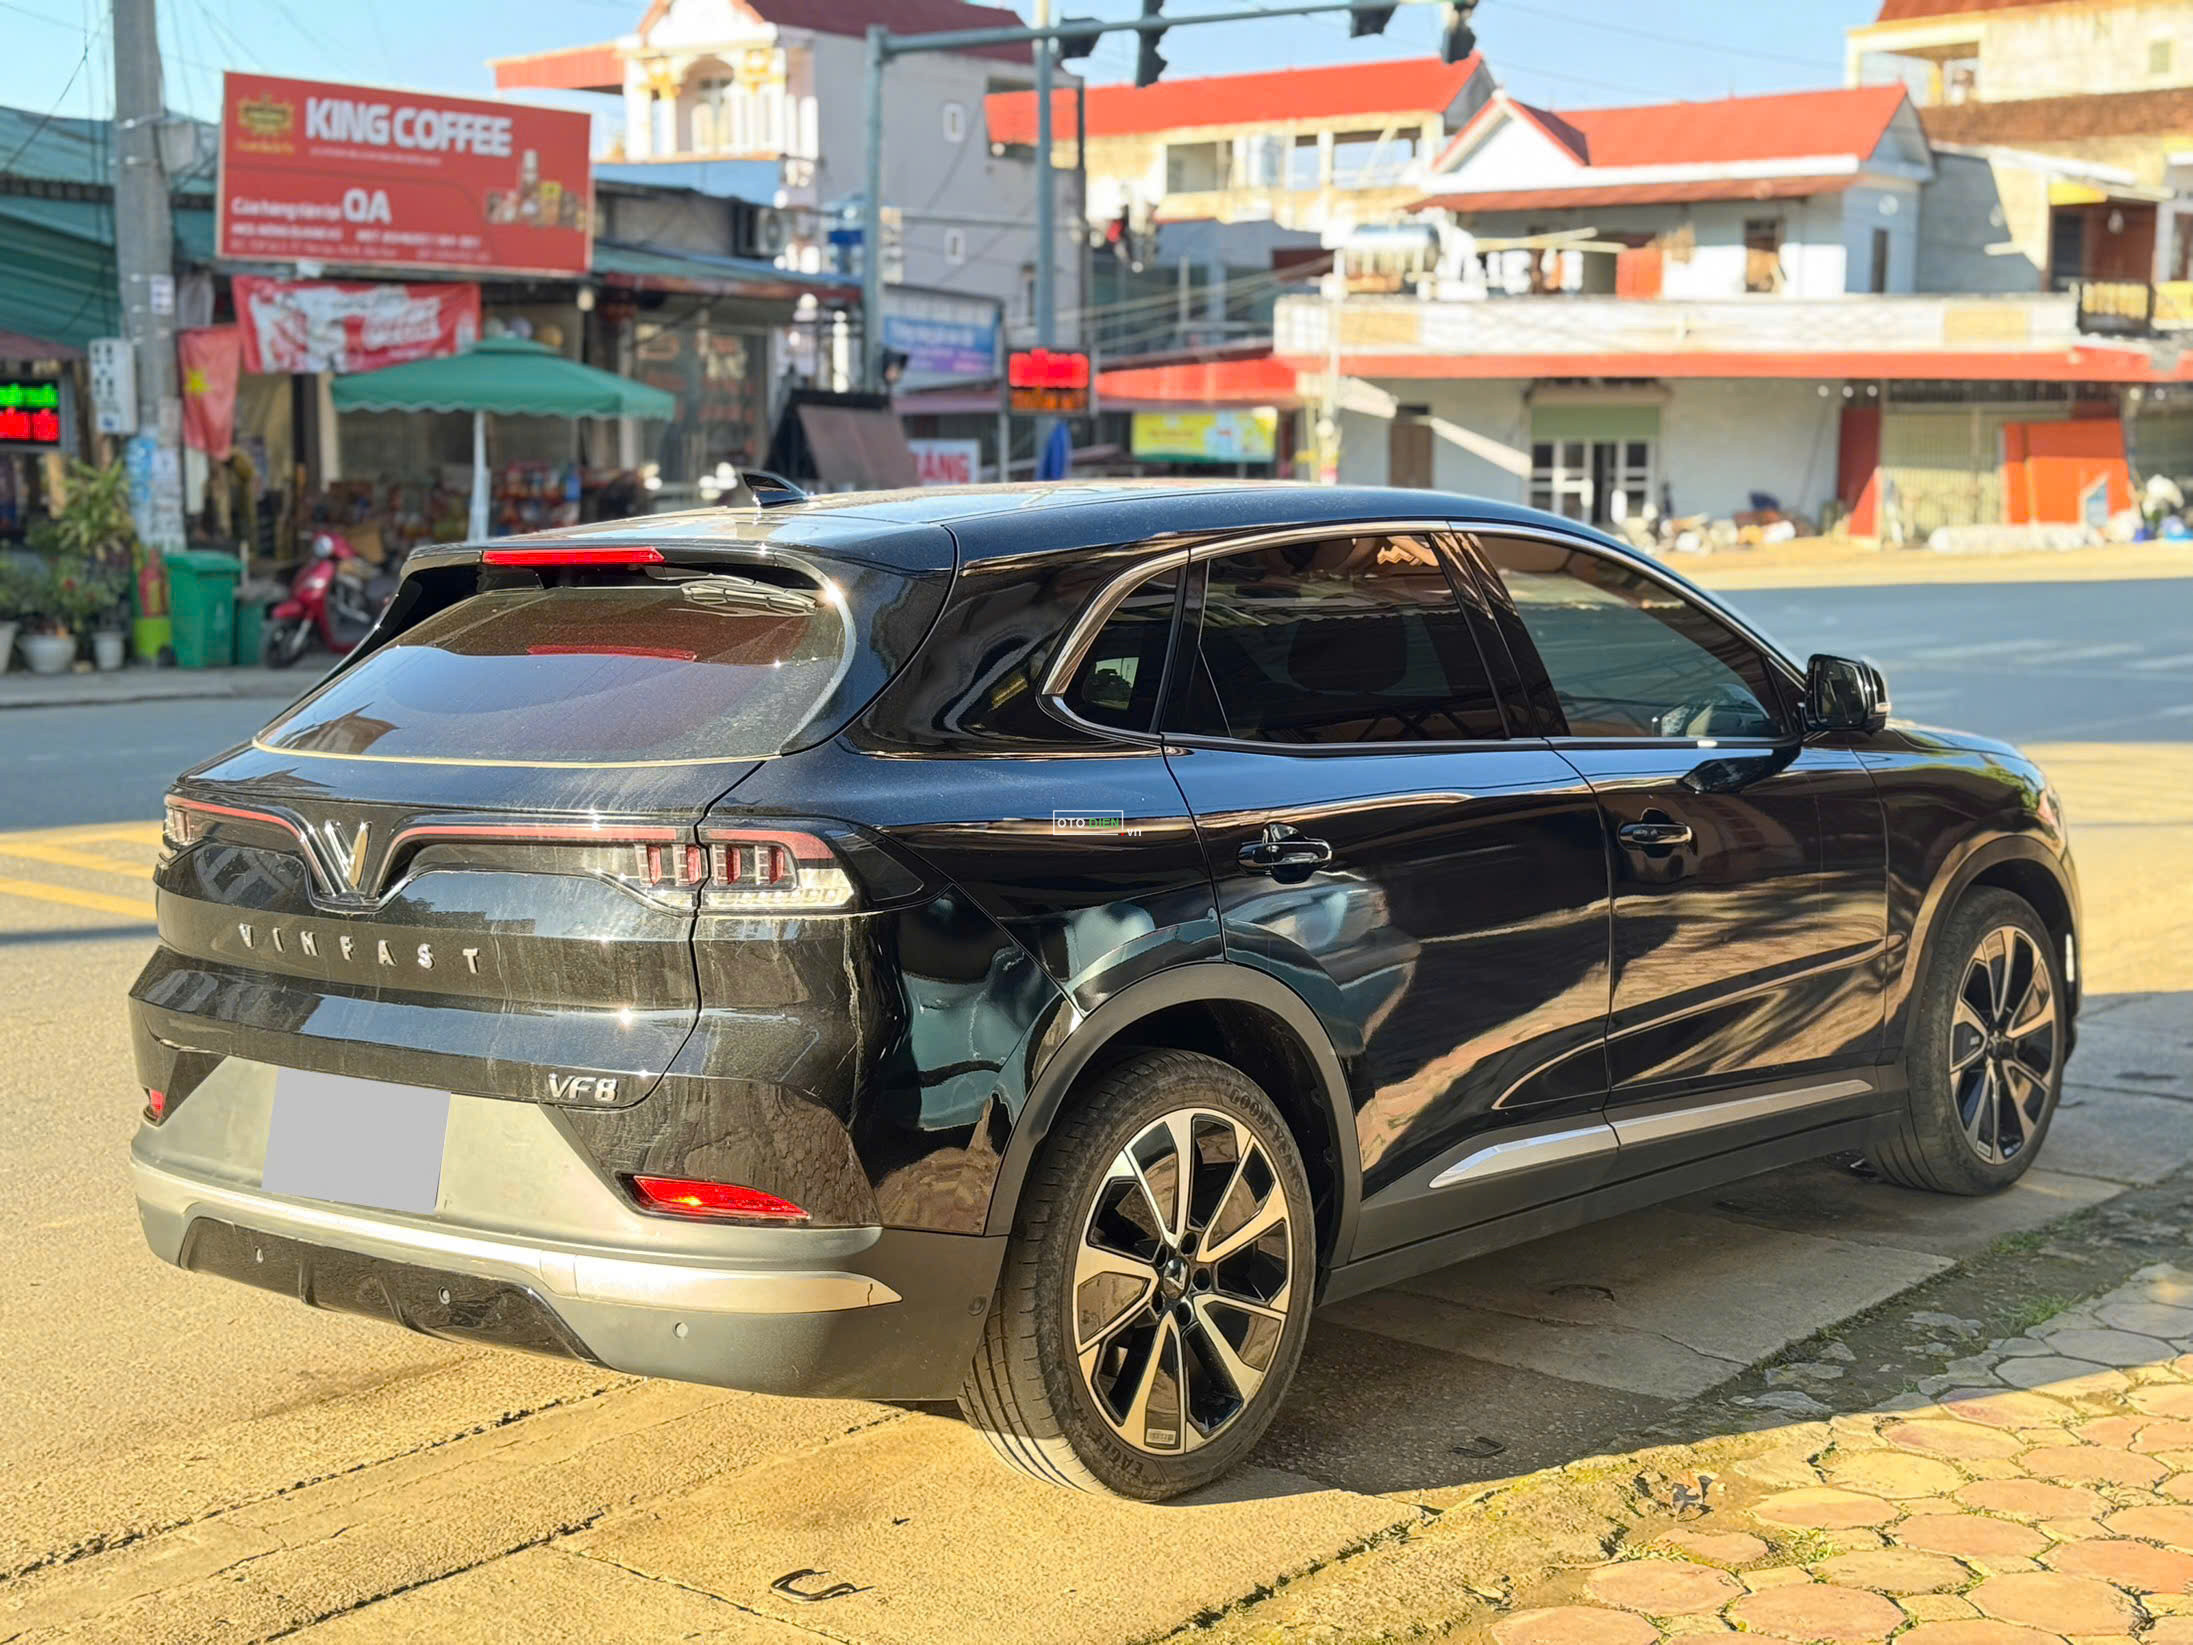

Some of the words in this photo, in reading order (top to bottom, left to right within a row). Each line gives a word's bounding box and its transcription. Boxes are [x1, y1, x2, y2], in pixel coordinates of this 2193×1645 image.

[305, 98, 390, 146] KING
[394, 109, 512, 157] COFFEE
[238, 923, 482, 975] VINFAST
